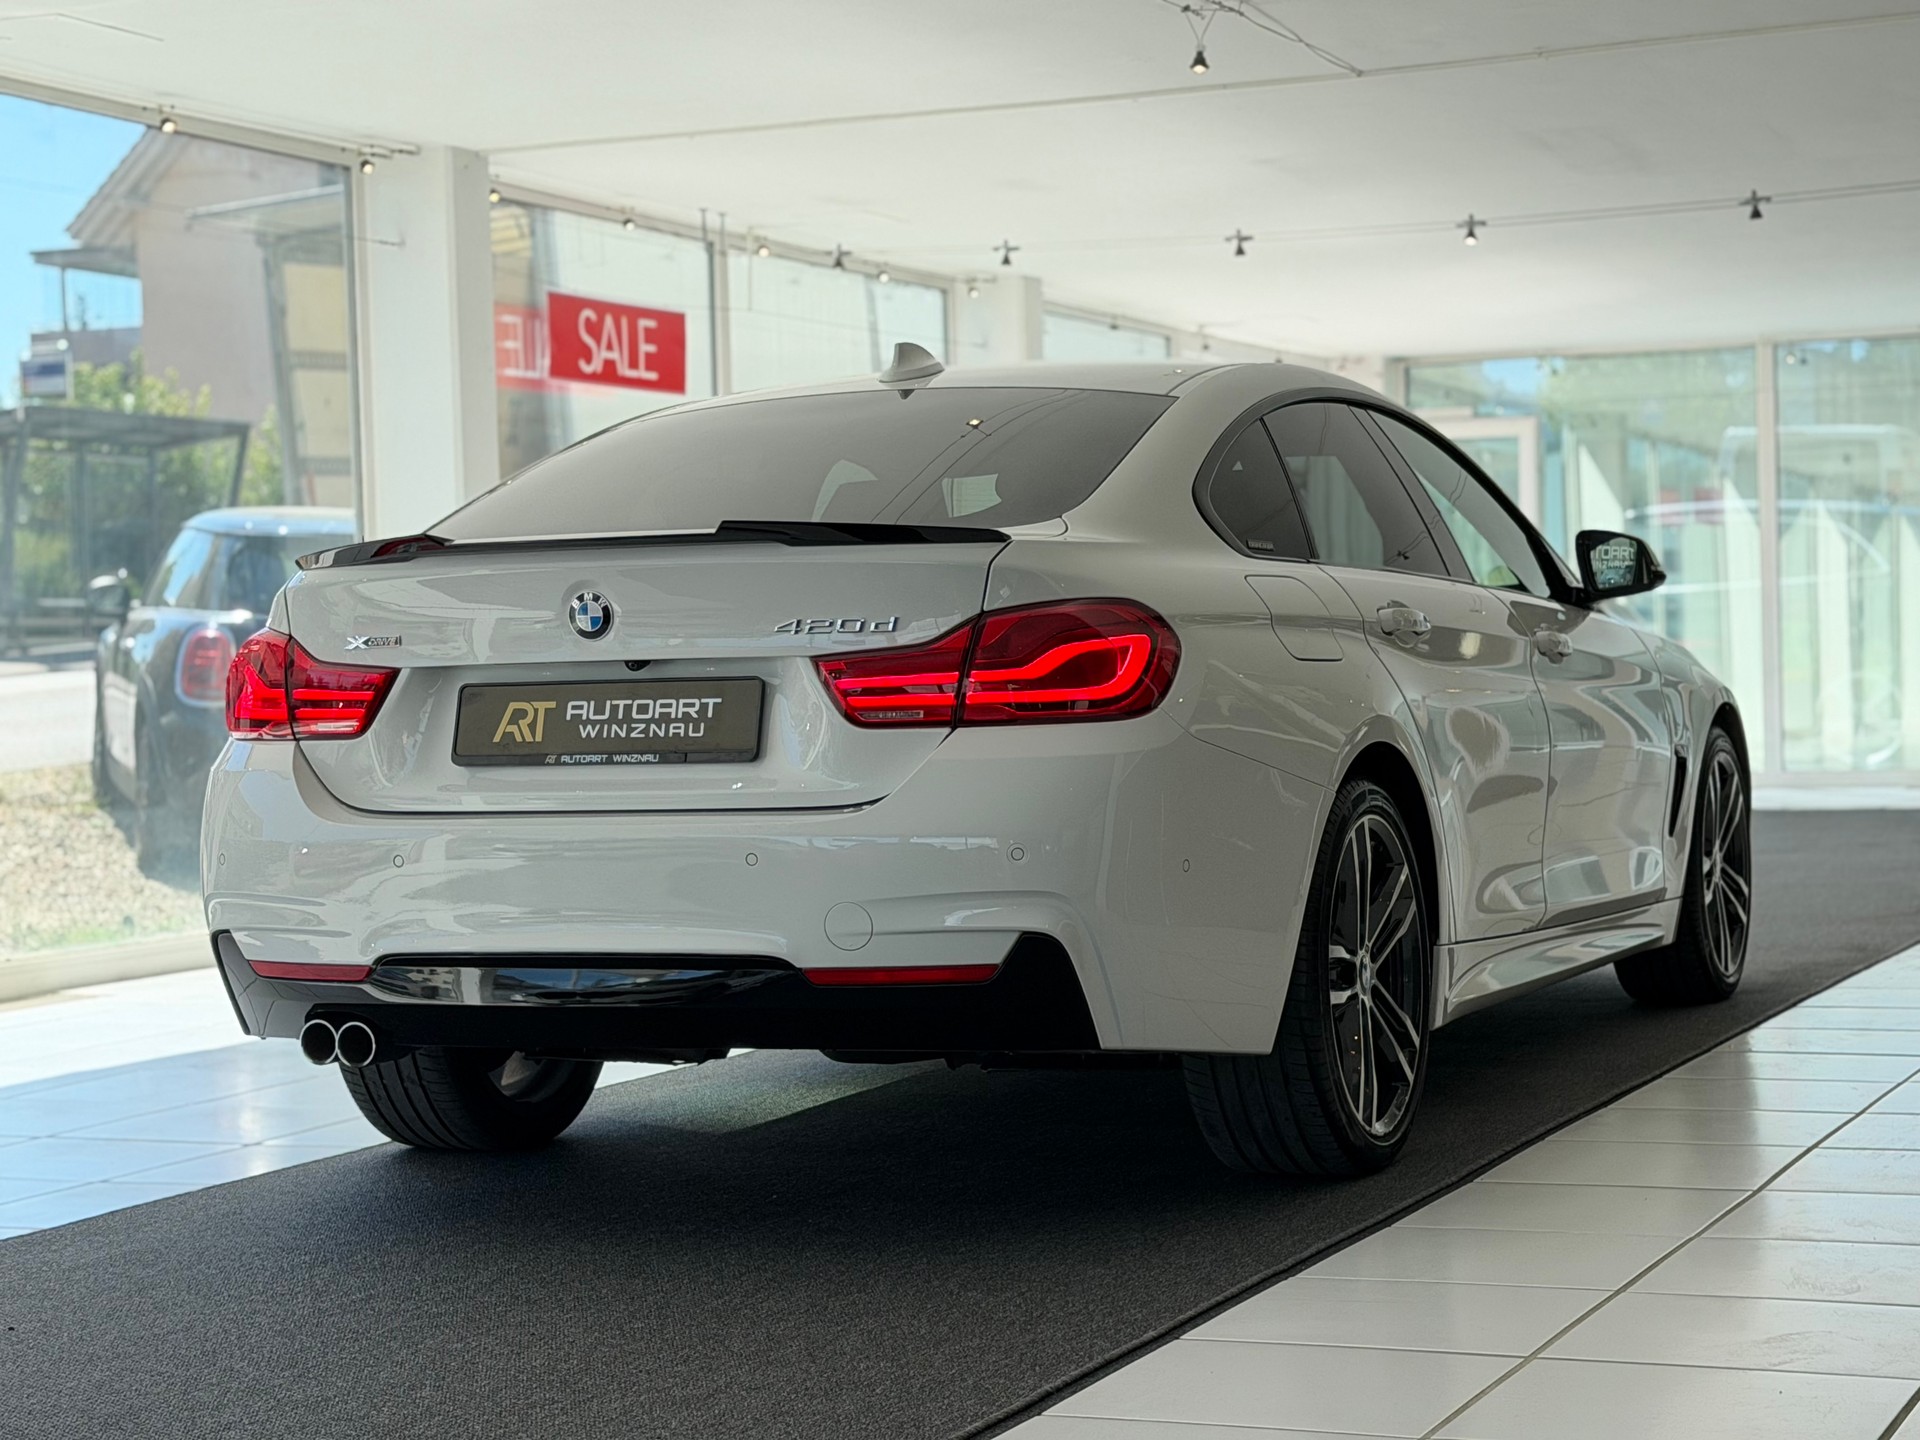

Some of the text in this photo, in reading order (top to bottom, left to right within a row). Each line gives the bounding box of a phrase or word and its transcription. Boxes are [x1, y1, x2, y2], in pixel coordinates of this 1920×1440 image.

[578, 308, 659, 381] SALE
[571, 591, 608, 609] BMW
[774, 616, 899, 635] 420d
[566, 698, 722, 720] AUTOART
[578, 722, 704, 738] WINZNAU
[561, 754, 608, 763] AUTOART
[612, 754, 659, 763] WINZNAU
